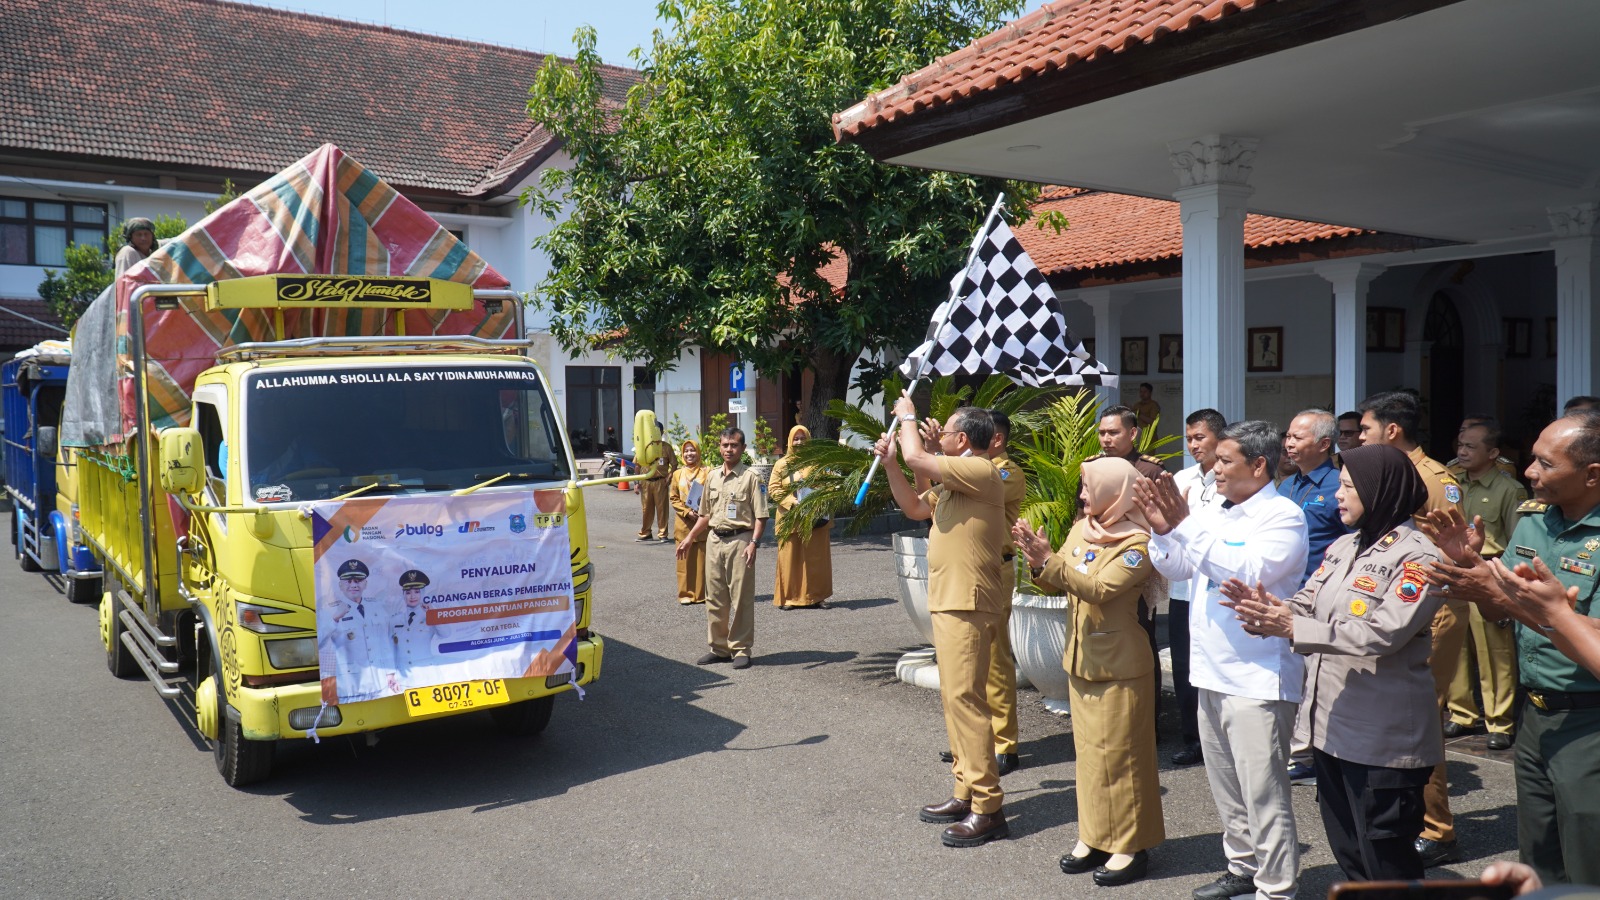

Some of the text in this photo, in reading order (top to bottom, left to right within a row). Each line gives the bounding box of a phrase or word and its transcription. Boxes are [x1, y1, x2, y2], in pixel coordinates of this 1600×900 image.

[256, 375, 338, 389] ALLAHUMMA
[340, 373, 384, 384] SHOLLI
[387, 373, 412, 382] ALA
[405, 523, 444, 537] bulog
[460, 562, 536, 579] PENYALURAN
[422, 581, 571, 605] CADANGAN BERAS PEMERINTAH
[437, 598, 559, 619] PROGRAM BANTUAN PANGAN
[480, 622, 521, 633] KOTA TEGAL
[470, 638, 493, 646] ALOKASI
[409, 690, 421, 707] G
[433, 683, 470, 703] 8097
